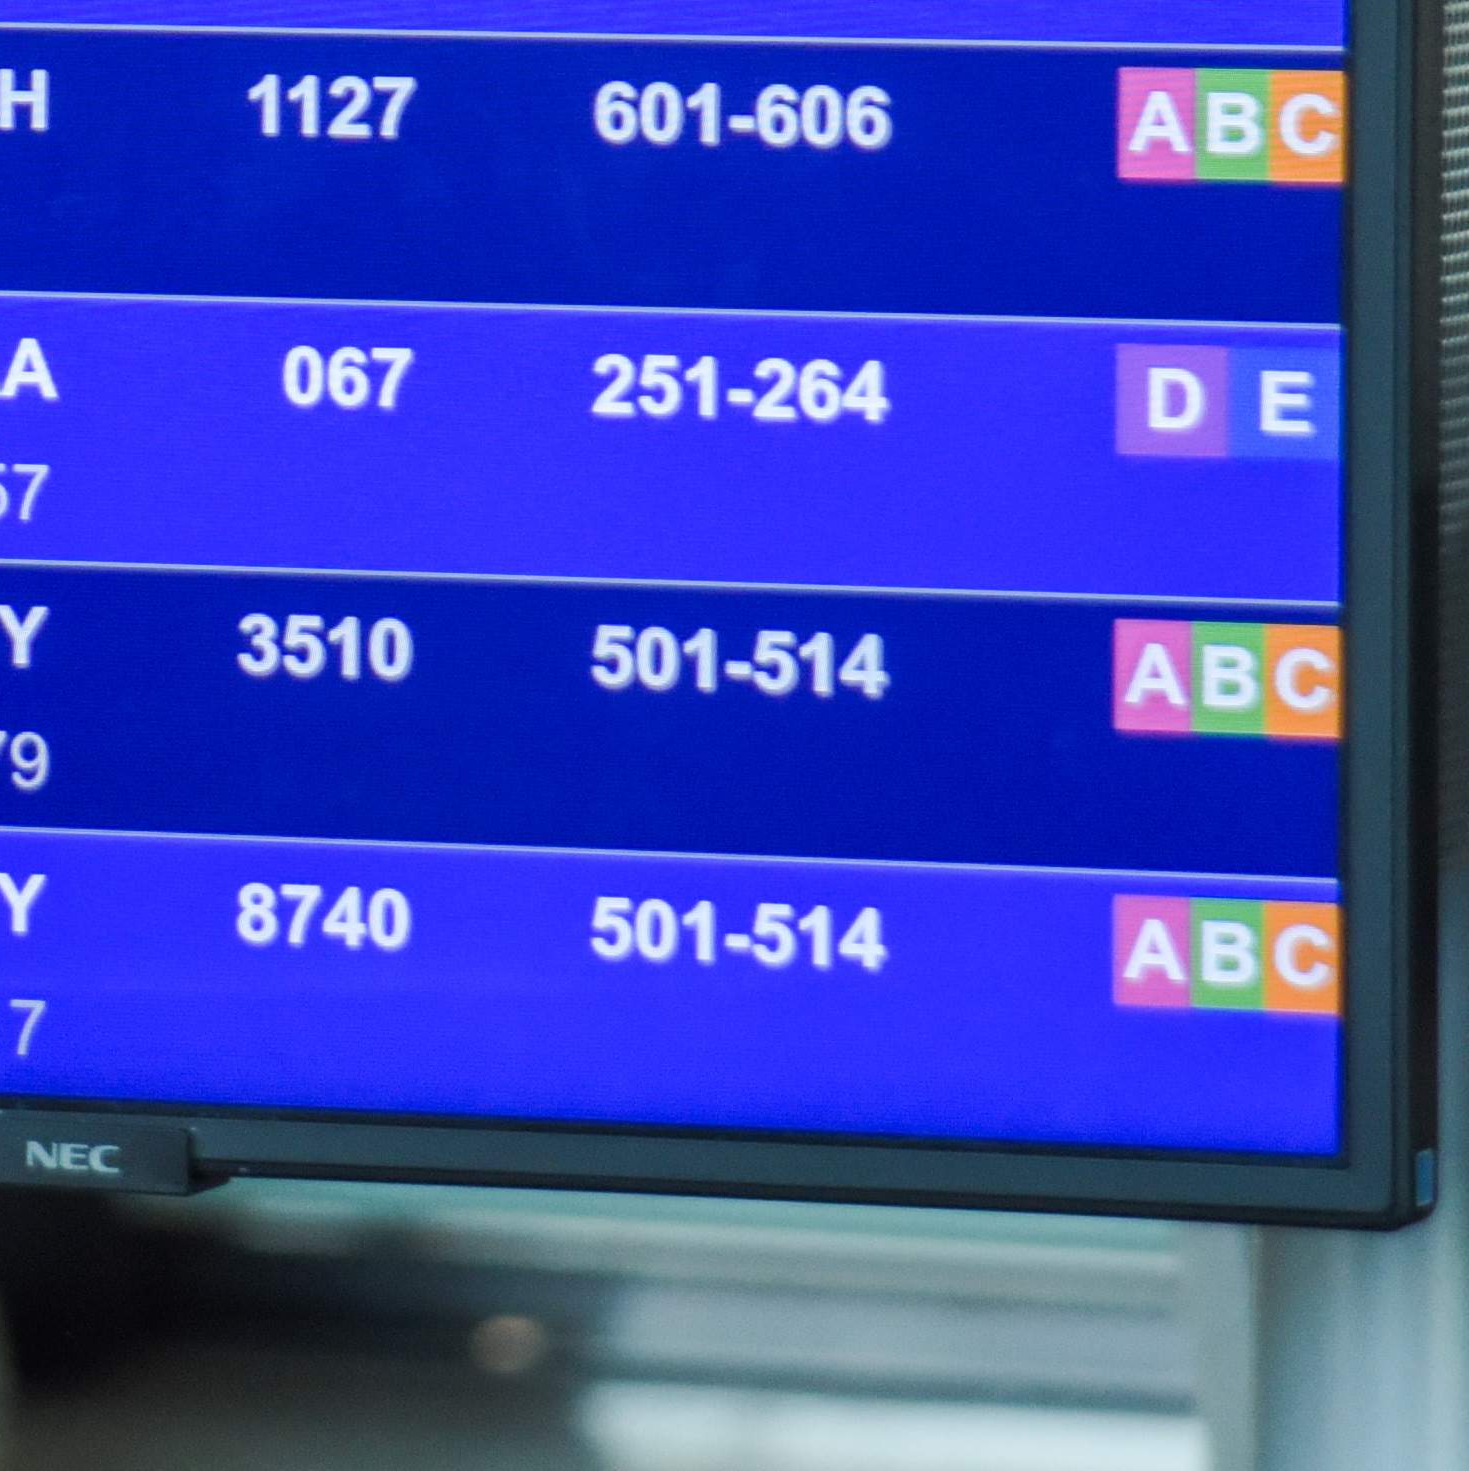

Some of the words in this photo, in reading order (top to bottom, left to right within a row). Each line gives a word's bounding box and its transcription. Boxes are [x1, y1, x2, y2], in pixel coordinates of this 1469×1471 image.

[247, 73, 416, 140] 1127
[593, 80, 891, 150] 601-606
[281, 344, 415, 411] 067
[590, 352, 891, 425] 251-264
[236, 612, 411, 682] 3510
[591, 623, 888, 699] 501-514
[235, 881, 412, 952] 8740
[589, 895, 889, 972] 501-514
[24, 1139, 122, 1175] NEC
